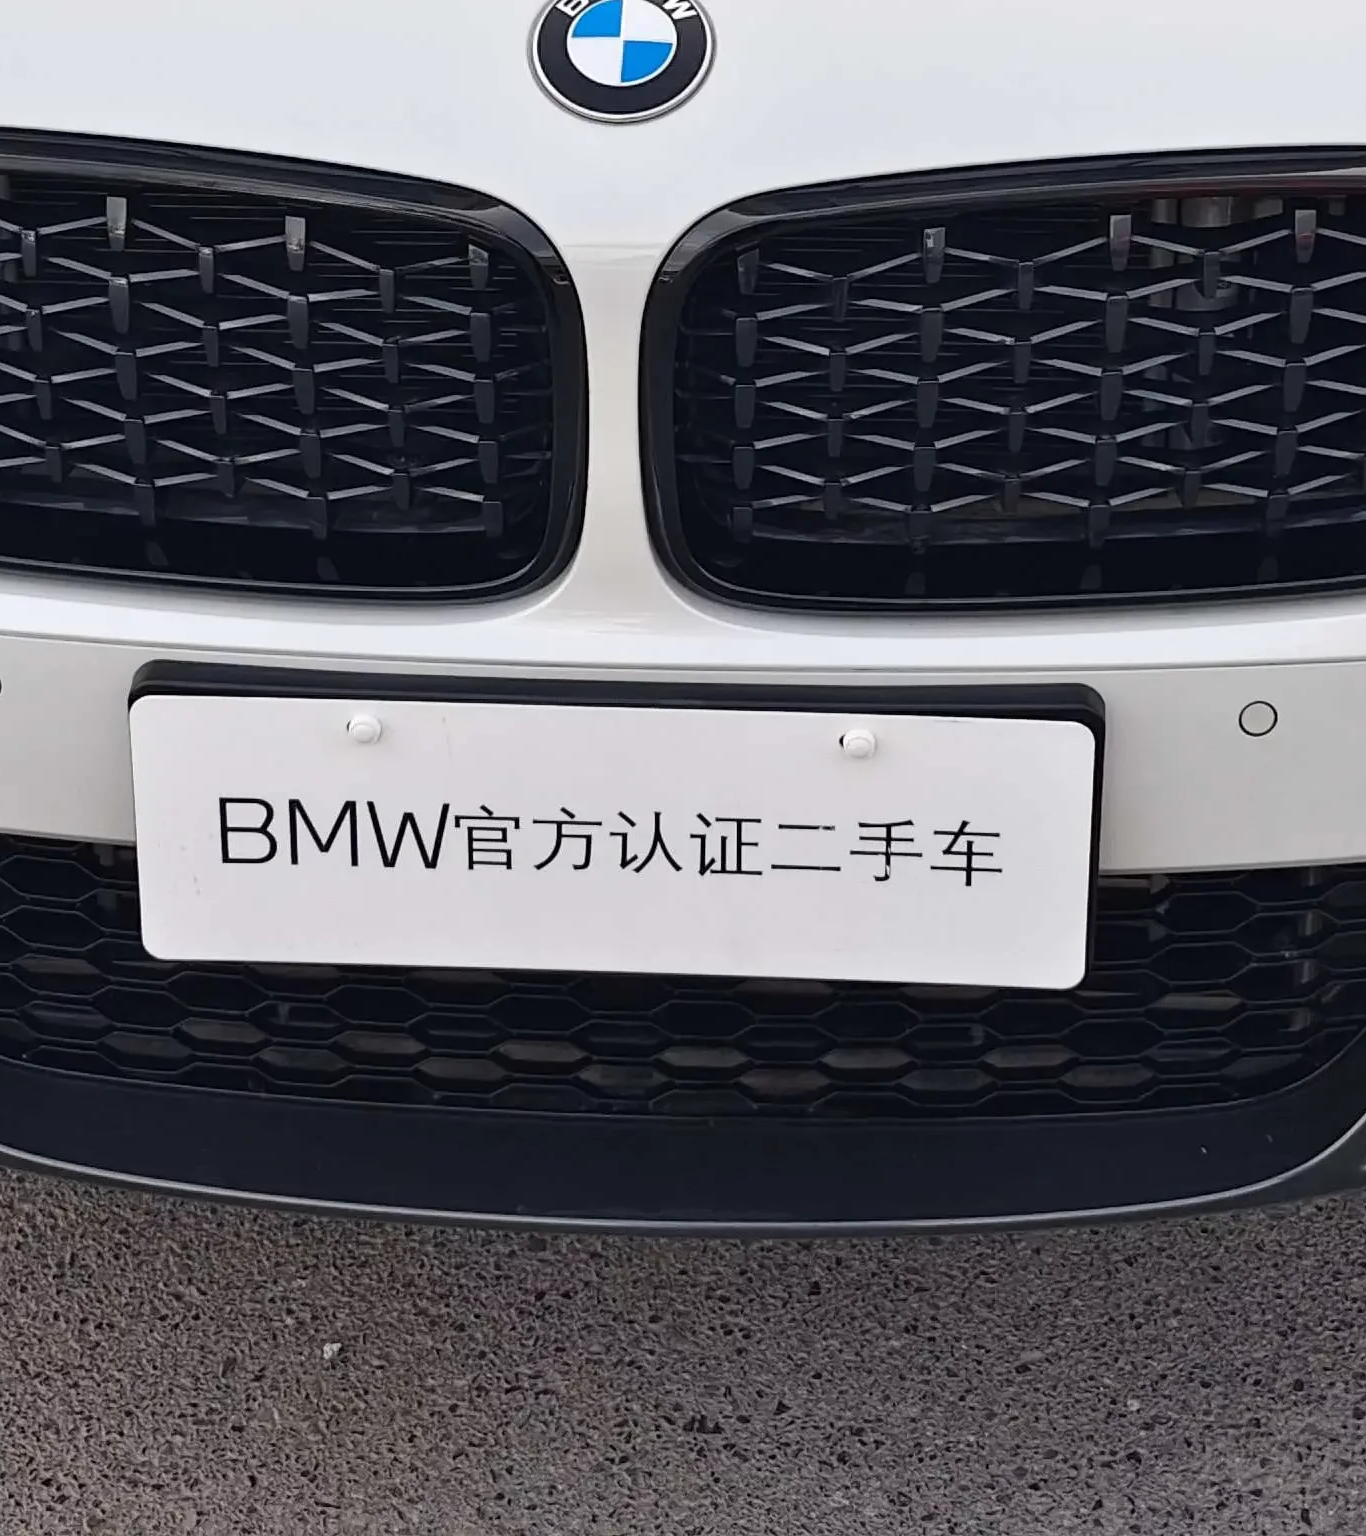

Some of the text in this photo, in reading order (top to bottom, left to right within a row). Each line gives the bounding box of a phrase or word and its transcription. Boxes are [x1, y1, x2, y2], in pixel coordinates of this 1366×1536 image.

[218, 795, 1003, 888] BMW官方认证二手车
